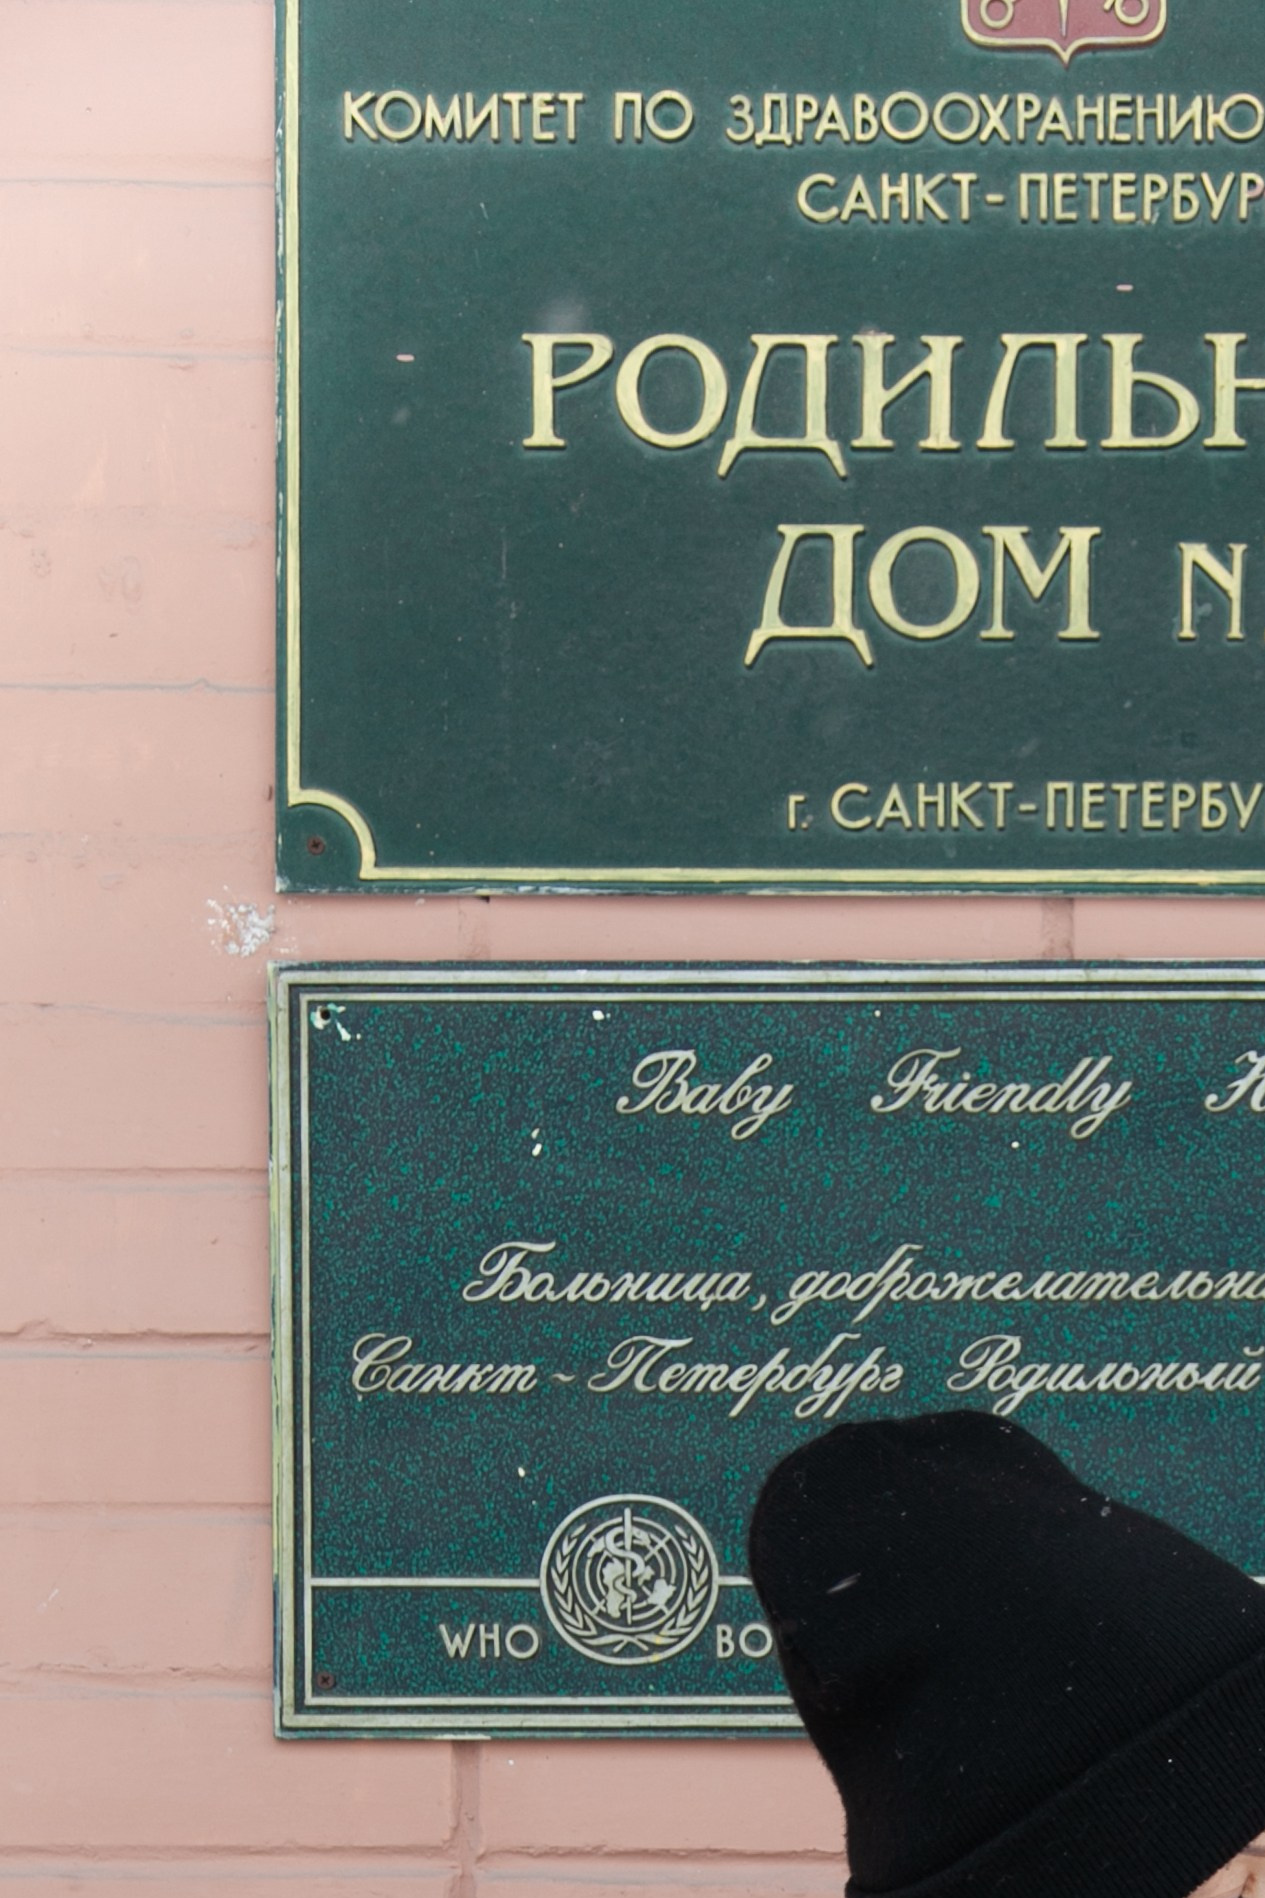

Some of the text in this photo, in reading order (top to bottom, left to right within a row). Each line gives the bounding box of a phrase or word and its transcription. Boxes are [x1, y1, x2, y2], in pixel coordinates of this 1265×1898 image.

[341, 89, 584, 141] КОМИТЕТ
[613, 89, 694, 140] ПО
[725, 90, 1265, 146] ЗДРАВООХРАНЕНИЮ
[744, 523, 1101, 665] ДОМ
[616, 1049, 794, 1140] Baby
[870, 1047, 1132, 1139] Friendly
[462, 1241, 767, 1311] Больница,
[946, 1334, 1265, 1417] Родильный
[439, 1623, 539, 1659] WHO
